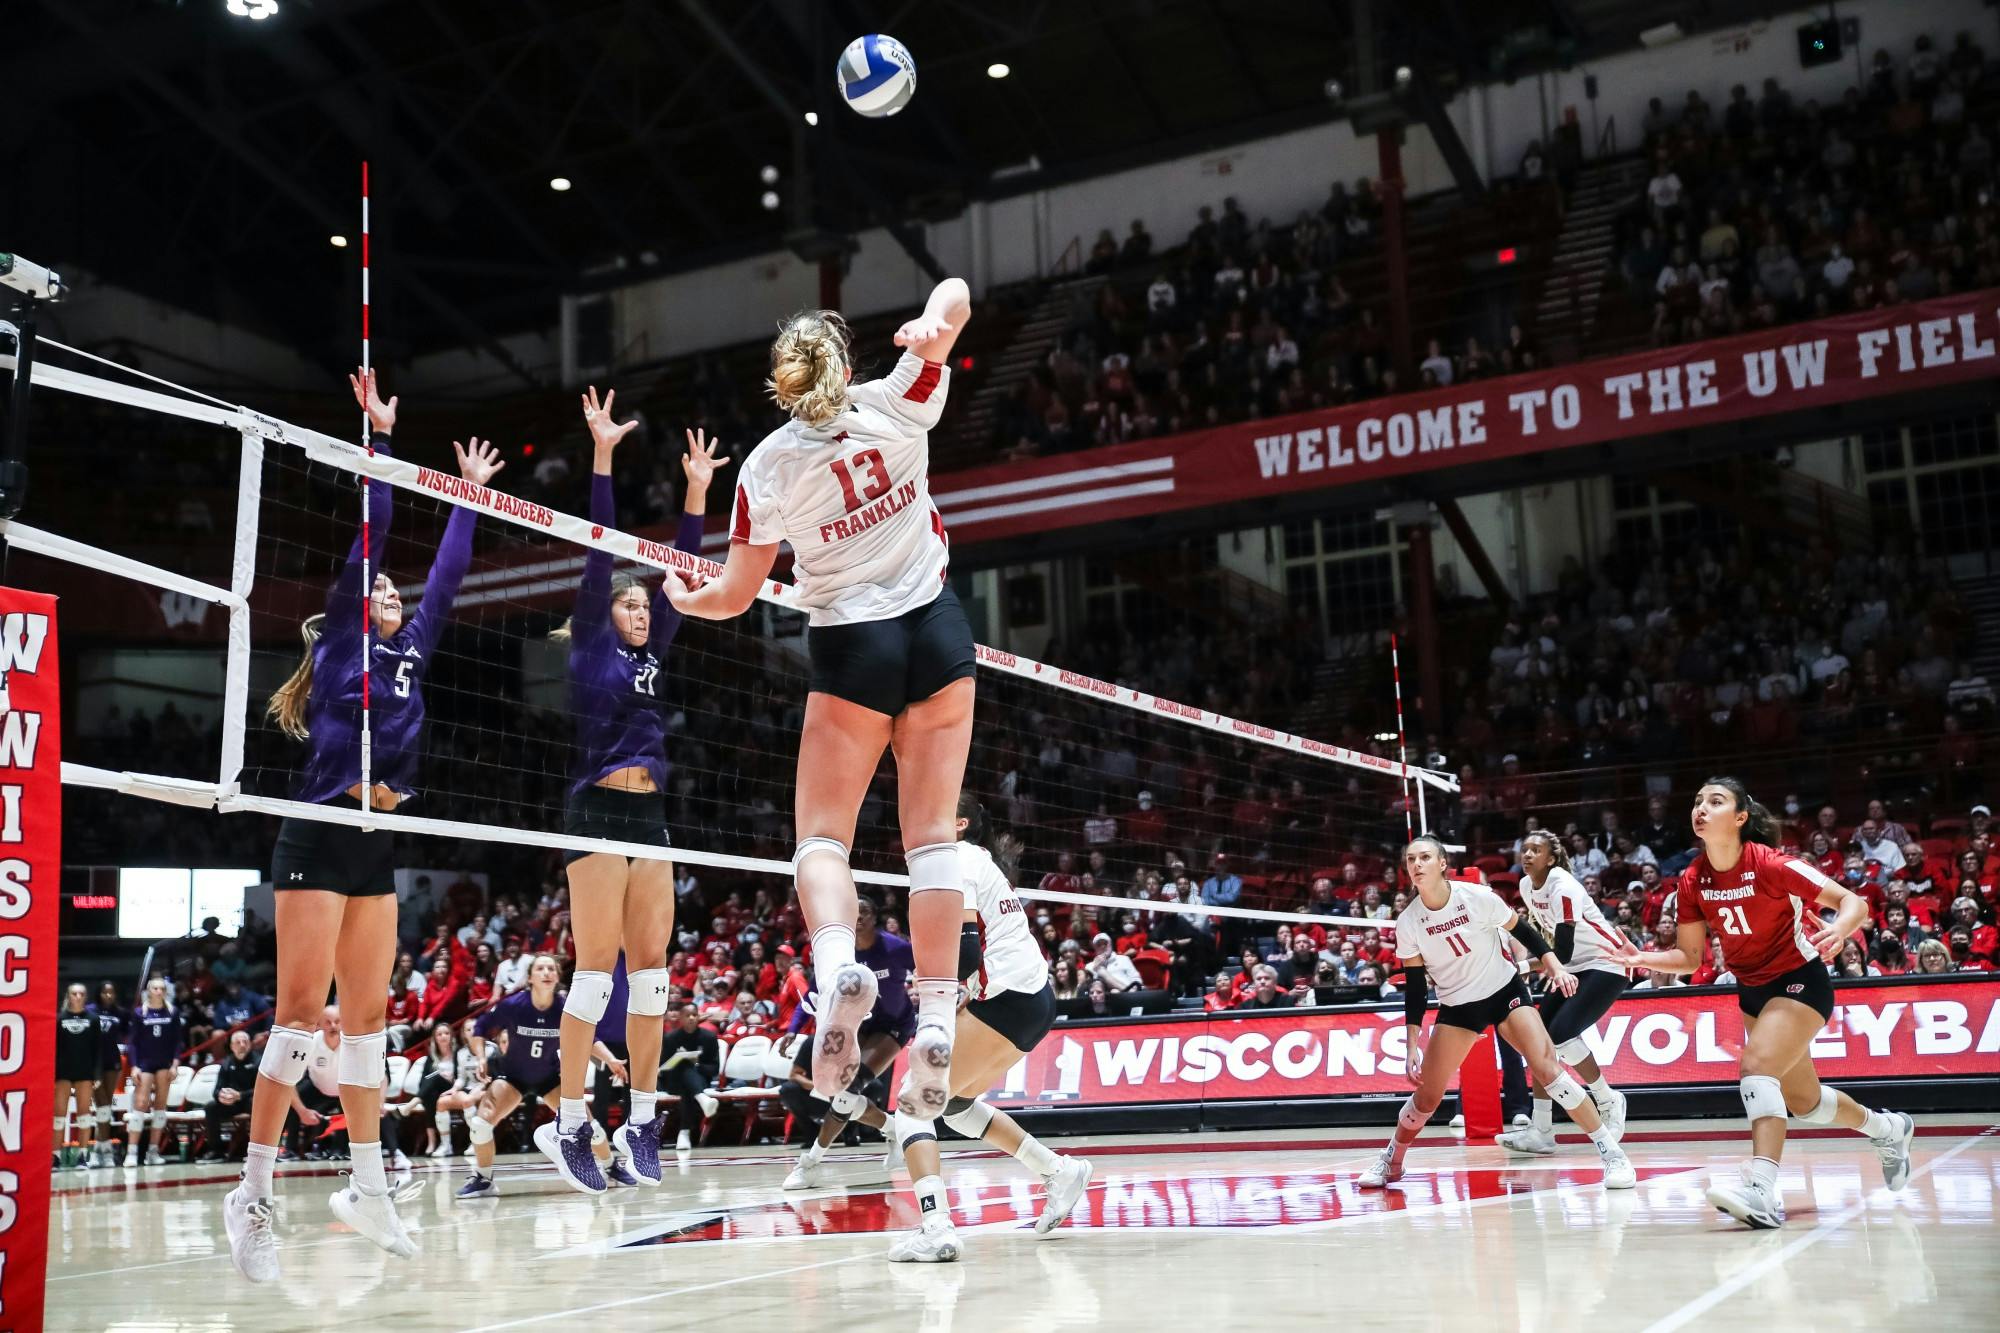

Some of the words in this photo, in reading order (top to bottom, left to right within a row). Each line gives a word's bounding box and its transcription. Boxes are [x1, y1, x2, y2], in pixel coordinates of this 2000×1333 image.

[1254, 400, 1487, 479] WELCOME
[1508, 384, 1581, 436] TO
[1604, 359, 1720, 420] THE
[1743, 338, 1829, 398] UW
[1856, 309, 2000, 378] FIEL
[416, 466, 492, 507] WISCONSIN
[493, 491, 555, 528] BADGERS
[829, 448, 893, 514] 13
[819, 479, 917, 543] FRANKLIN
[637, 538, 695, 572] WISCONSIN
[697, 556, 725, 579] BADG
[394, 660, 414, 698] 5
[1701, 884, 1755, 901] WISCONSIN
[1425, 913, 1470, 936] WISCONSIN
[1718, 905, 1753, 935] 21
[1445, 932, 1472, 957] 11
[152, 1024, 162, 1037] 8
[530, 1040, 544, 1058] 6
[1093, 1025, 1436, 1087] WISCONS
